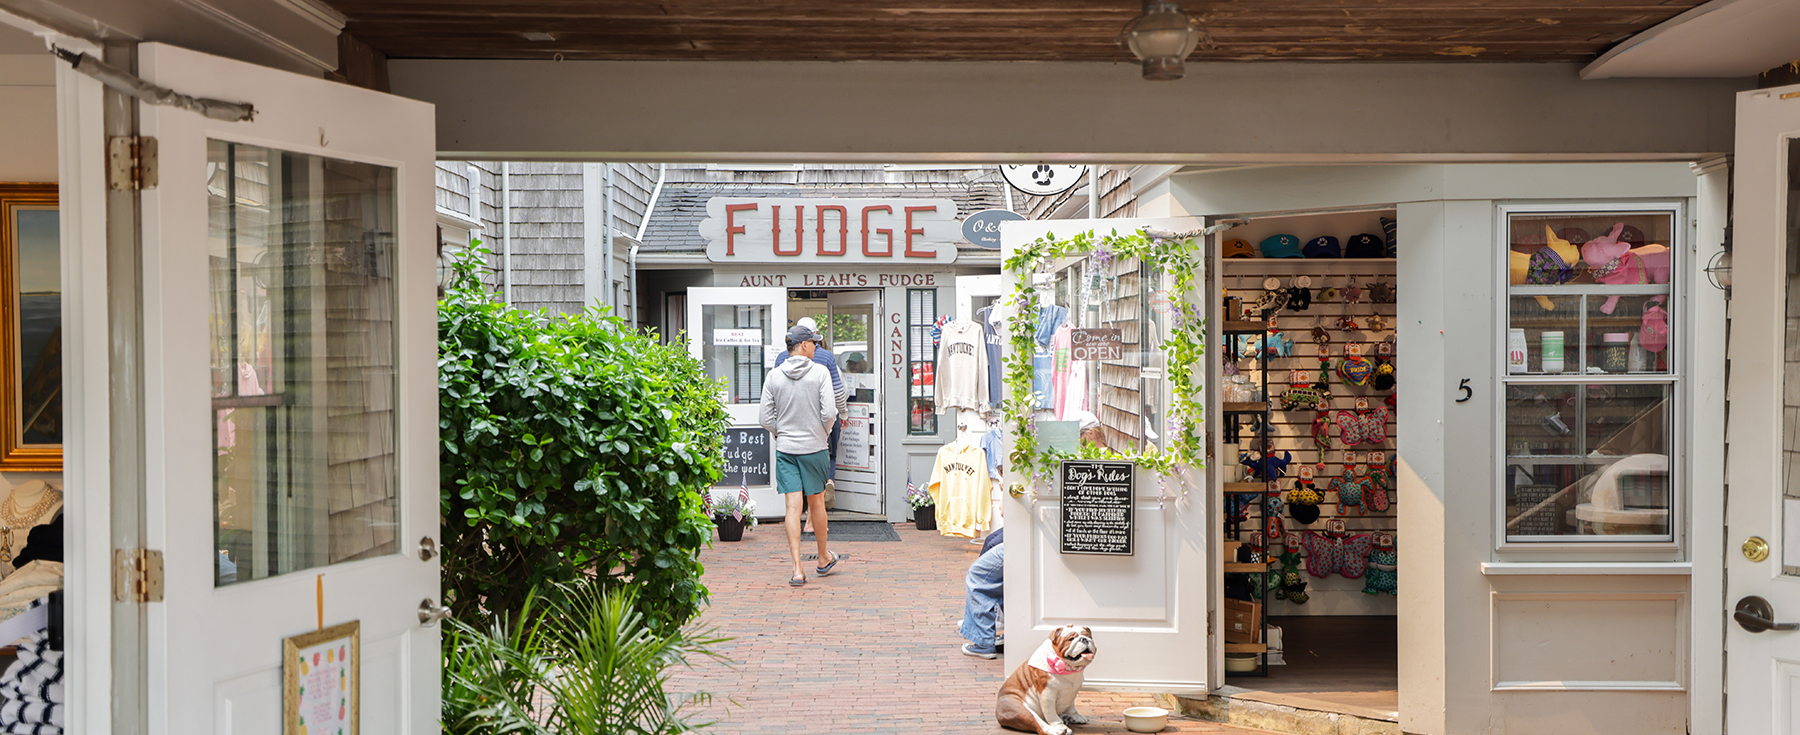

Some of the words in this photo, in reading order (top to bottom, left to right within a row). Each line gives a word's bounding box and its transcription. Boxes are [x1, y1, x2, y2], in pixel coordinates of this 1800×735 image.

[725, 202, 937, 258] FUDGE
[740, 275, 787, 287] AUNT
[803, 273, 867, 287] LEAH'S
[879, 274, 936, 286] FUDGE
[891, 312, 902, 379] CANDY
[1071, 331, 1108, 346] Come
[1110, 333, 1121, 342] in
[1073, 346, 1121, 360] OPEN
[1455, 377, 1473, 403] 5
[739, 431, 765, 445] Best
[721, 446, 753, 464] Fudge
[741, 463, 768, 475] world
[1067, 467, 1096, 486] Dog's
[1097, 468, 1130, 483] Rules
